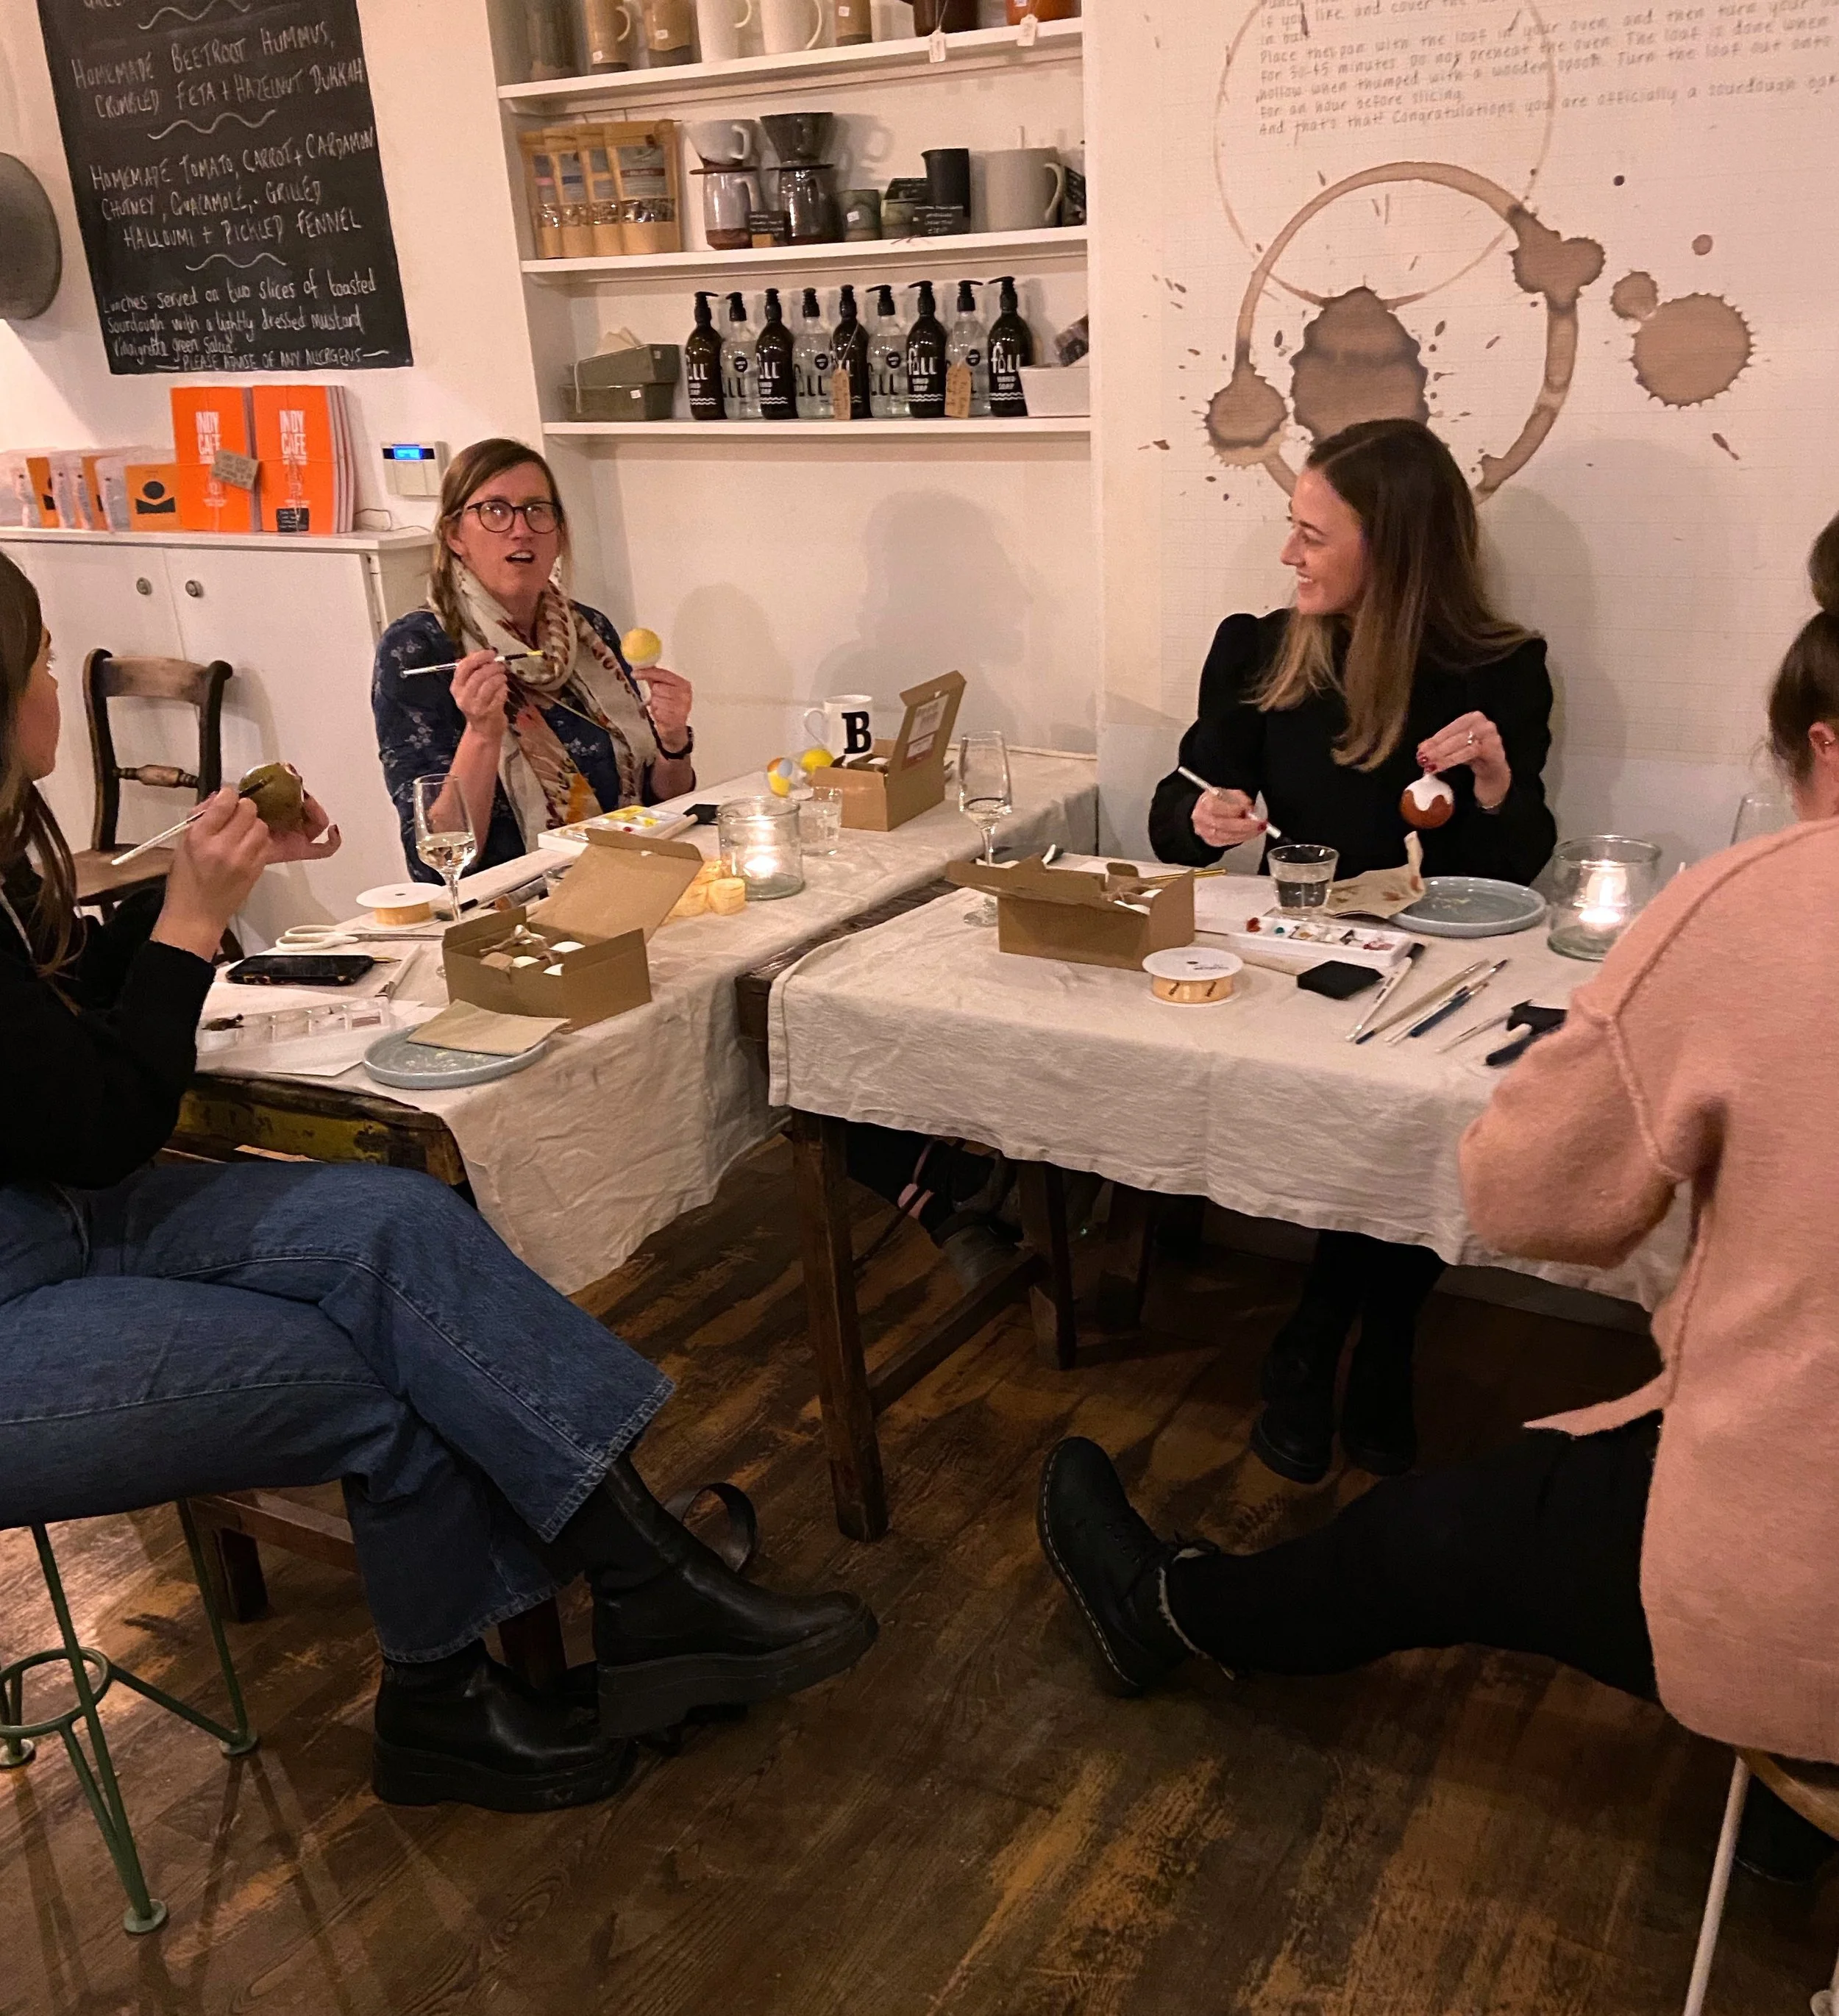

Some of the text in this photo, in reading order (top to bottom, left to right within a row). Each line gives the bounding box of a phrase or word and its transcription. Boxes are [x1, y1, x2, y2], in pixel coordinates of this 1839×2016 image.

[1421, 34, 1445, 48] the
[1623, 9, 1653, 26] and
[1665, 7, 1704, 22] then
[1718, 3, 1757, 17] turn
[1734, 19, 1774, 35] done
[176, 80, 216, 110] FETA
[243, 137, 294, 173] CARROT
[266, 175, 321, 206] GRILLED
[124, 225, 196, 251] HALLOUMI
[221, 214, 283, 245] PICKLED
[296, 206, 363, 238] FENNEL
[205, 288, 220, 302] on
[226, 277, 251, 303] two
[303, 268, 318, 299] of
[327, 267, 377, 296] toasted
[841, 710, 872, 755] B
